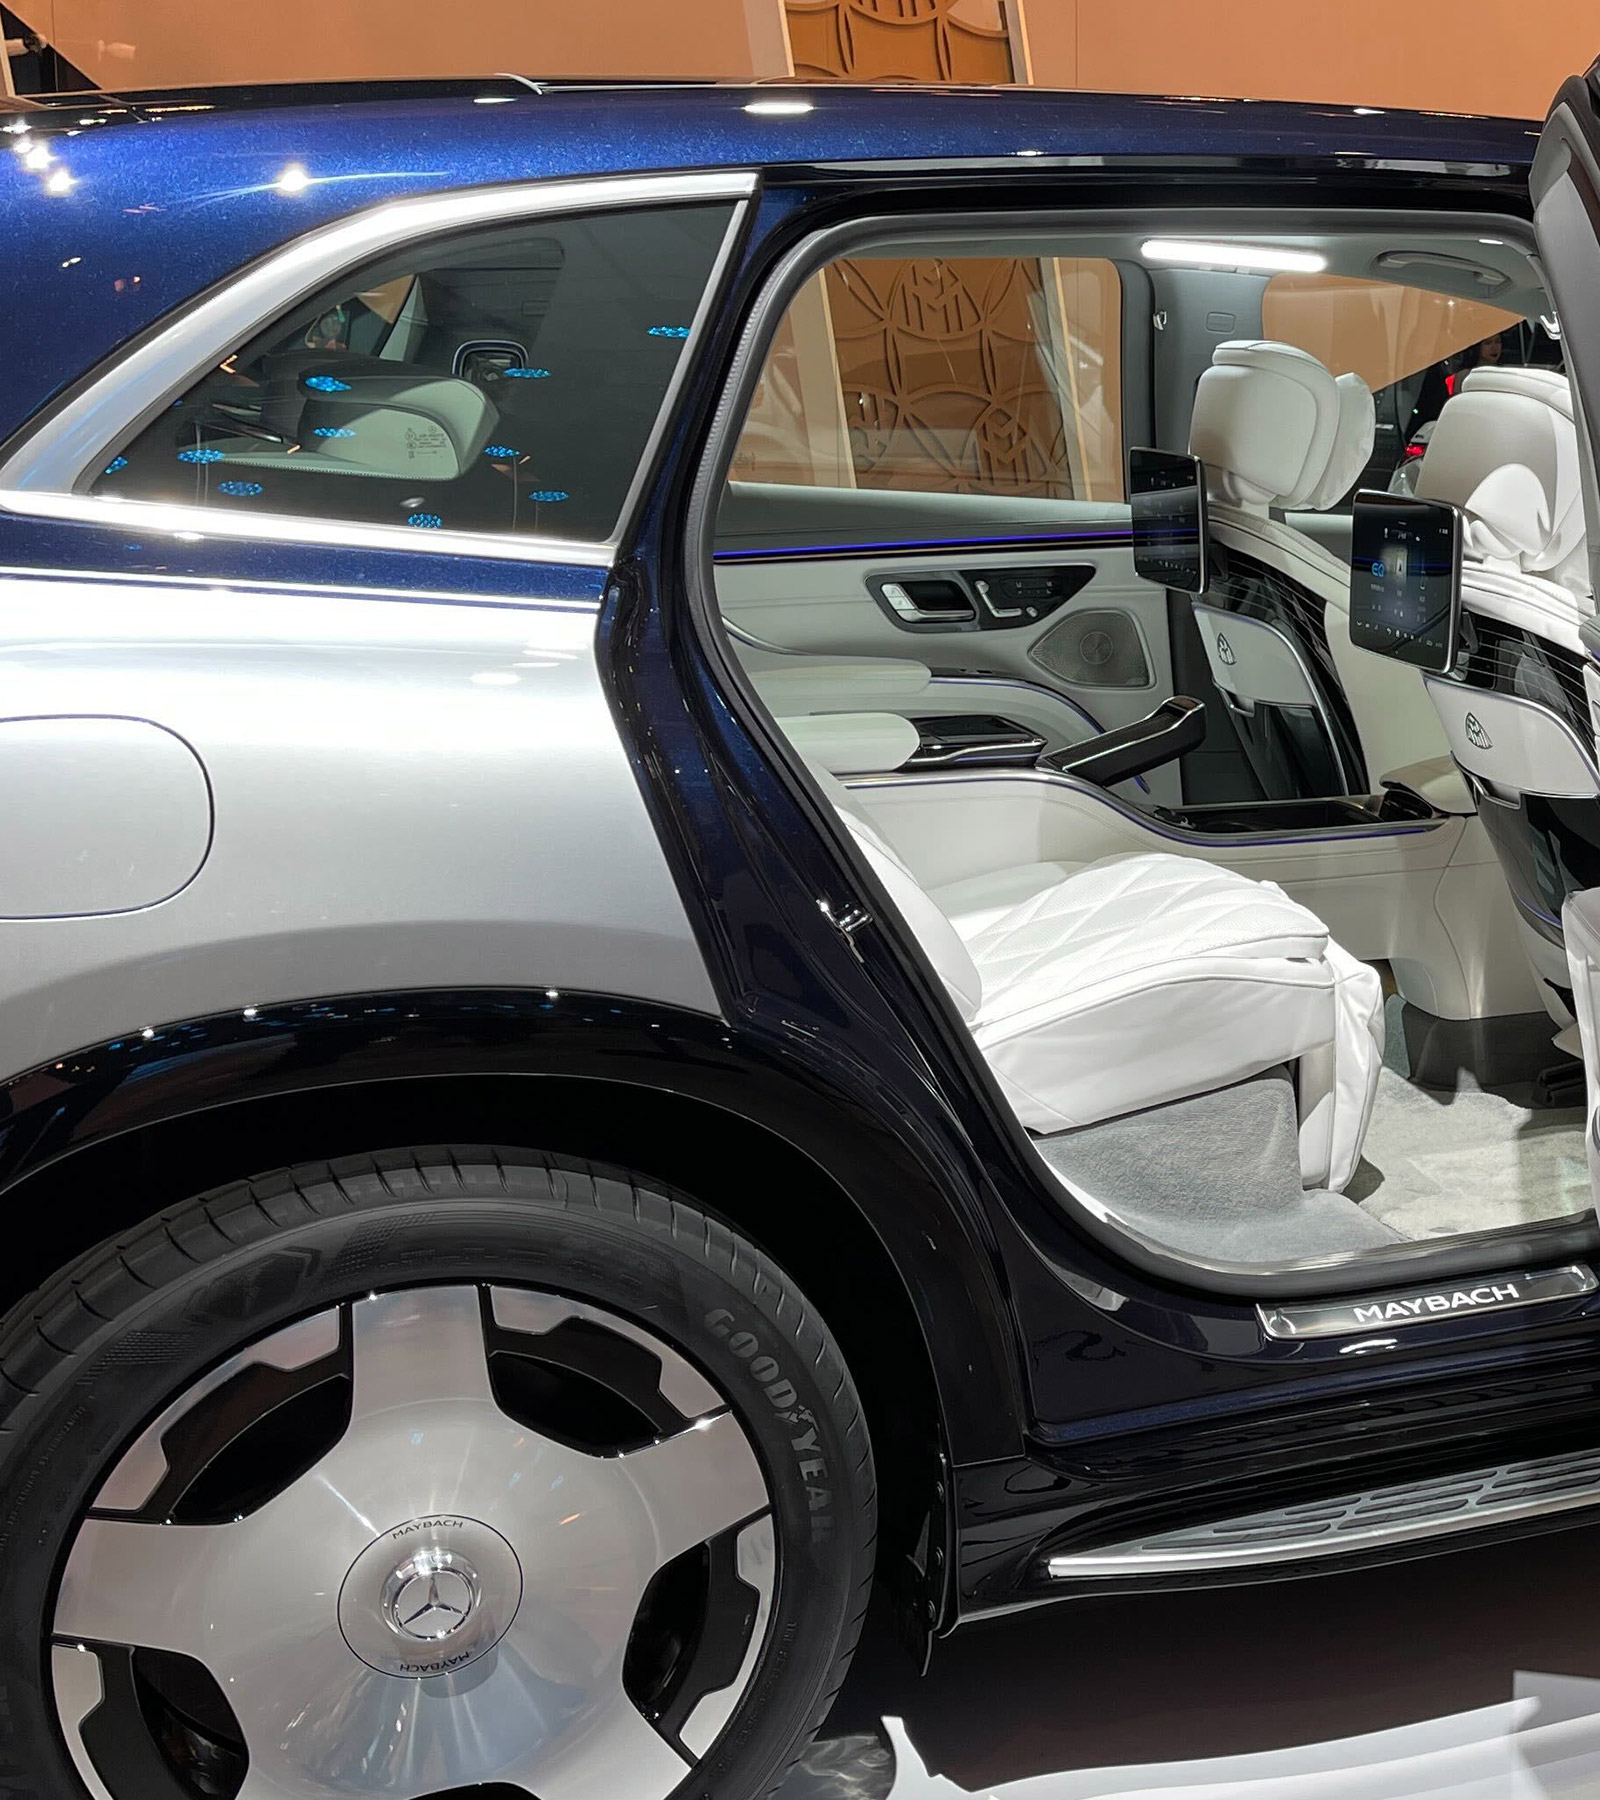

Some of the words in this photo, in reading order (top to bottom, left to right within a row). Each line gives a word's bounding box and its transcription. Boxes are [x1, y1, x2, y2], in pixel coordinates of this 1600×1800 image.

[1353, 1283, 1519, 1323] MAYBACH
[704, 1308, 836, 1544] GOODYEAR
[392, 1519, 464, 1539] MAYBACH
[400, 1651, 472, 1672] MAYBACH
